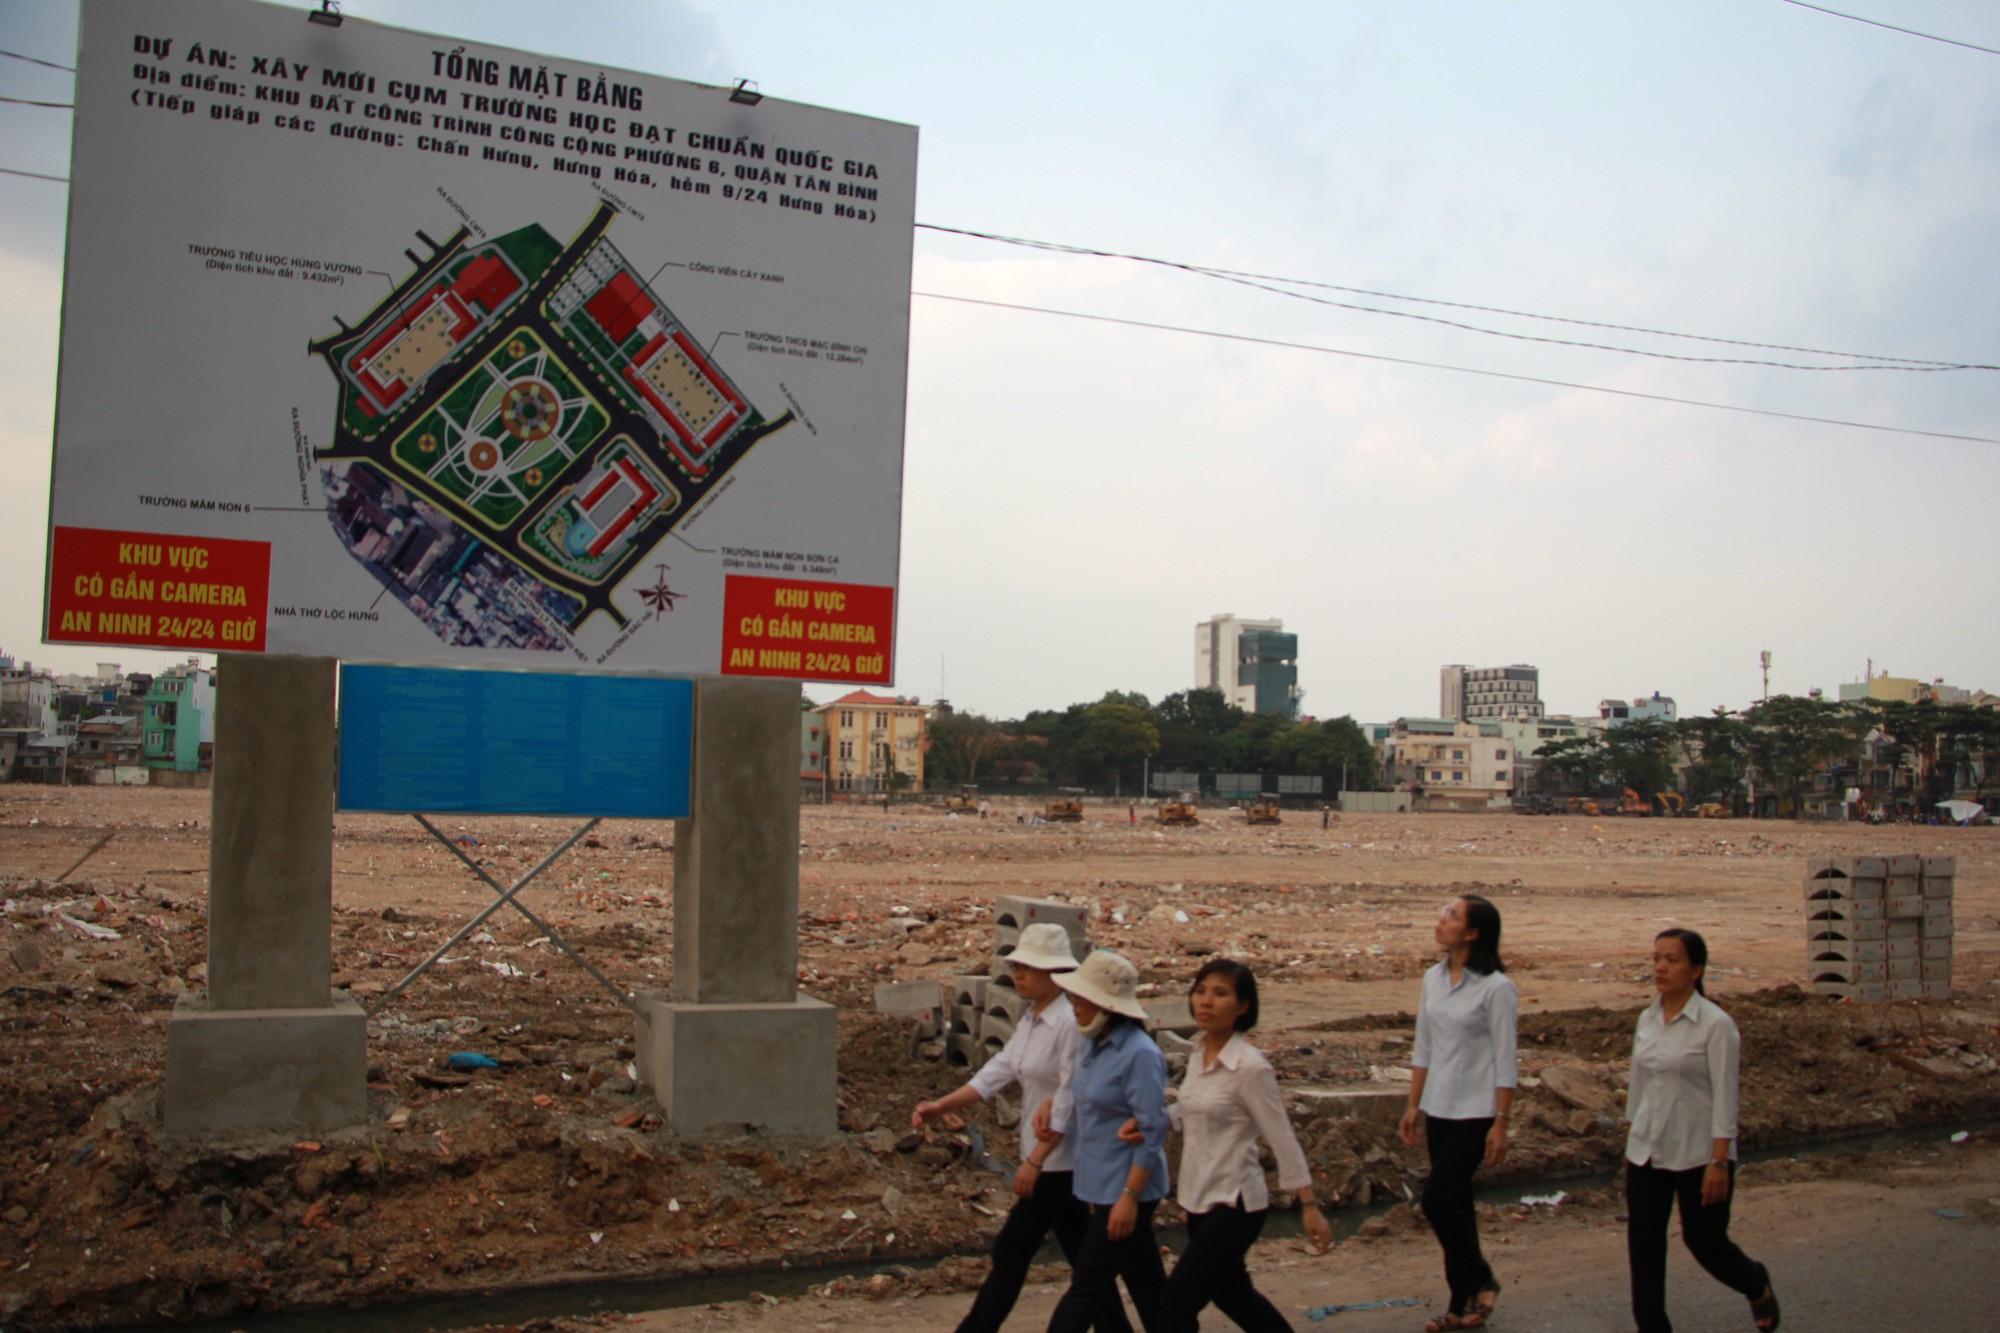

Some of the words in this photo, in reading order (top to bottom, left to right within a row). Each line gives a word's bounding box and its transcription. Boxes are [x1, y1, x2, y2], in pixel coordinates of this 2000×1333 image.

[432, 46, 499, 86] TỔNG
[509, 65, 568, 99] MẶT
[577, 72, 643, 111] BẰNG
[134, 34, 173, 60] DỰ
[187, 42, 237, 70] ÁN:
[251, 55, 309, 82] XÂY
[322, 68, 376, 93] MỚI
[388, 80, 448, 106] CỤM
[460, 92, 557, 124] TRƯỜNG
[569, 112, 617, 136] HỌC
[628, 121, 677, 145] ĐẠT
[688, 131, 765, 160] CHUẨN
[775, 147, 834, 172] QUỐC
[843, 159, 879, 180] GIA
[133, 63, 171, 85] Địa
[180, 72, 247, 98] điểm:
[255, 85, 301, 106] KHU
[310, 93, 355, 115] ĐẤT
[364, 103, 422, 126] CÔNG
[431, 113, 493, 137] TRÌNH
[500, 125, 556, 147] CÔNG
[563, 135, 617, 157] CỘNG
[624, 146, 701, 171] PHƯỜNG
[708, 160, 727, 177] 6,
[735, 164, 787, 186] QUẬN
[794, 174, 831, 194] TÂN
[837, 180, 879, 202] BÌNH
[131, 88, 195, 115] (Tiếp
[210, 103, 260, 126] giáp
[274, 113, 316, 133] các
[330, 122, 404, 148] đường:
[418, 135, 471, 157] Chấn
[483, 146, 540, 171] Hưng,
[553, 157, 602, 180] Hưng
[614, 167, 658, 189] Hóa,
[670, 175, 711, 195] hẻm
[723, 184, 768, 205] 9/24
[780, 194, 823, 216] Hưng
[834, 203, 877, 224] Hóa)
[188, 244, 236, 260] TRƯỜNG
[265, 254, 289, 267] HỌC
[291, 256, 321, 270] HÙNG
[324, 261, 363, 276] VƯƠNG
[205, 259, 232, 273] (Diện
[257, 265, 276, 277] khu
[139, 495, 187, 509] TRƯỜNG
[219, 500, 242, 512] NON
[245, 503, 251, 513] 6
[119, 543, 162, 566] KHU
[168, 546, 209, 573] VỰC
[827, 555, 840, 565] CA
[74, 572, 103, 598] CÓ
[110, 571, 154, 600] GẮN
[161, 580, 247, 607] CAMERA
[775, 588, 810, 610] KHU
[814, 590, 846, 614] VỰC
[60, 610, 92, 633] AN
[98, 613, 151, 637] NINH
[157, 615, 216, 641] 24/24
[221, 615, 257, 642] GIỜ
[274, 605, 297, 618] NHÀ
[300, 607, 323, 619] THỜ
[324, 609, 346, 622] LỌC
[349, 610, 380, 622] HƯNG
[740, 616, 765, 636] CÓ
[768, 613, 804, 639] GẮN
[808, 622, 876, 644] CAMERA
[730, 648, 755, 667] AN
[759, 649, 801, 671] NINH
[805, 653, 851, 673] 24/24
[855, 652, 884, 675] GIỜ
